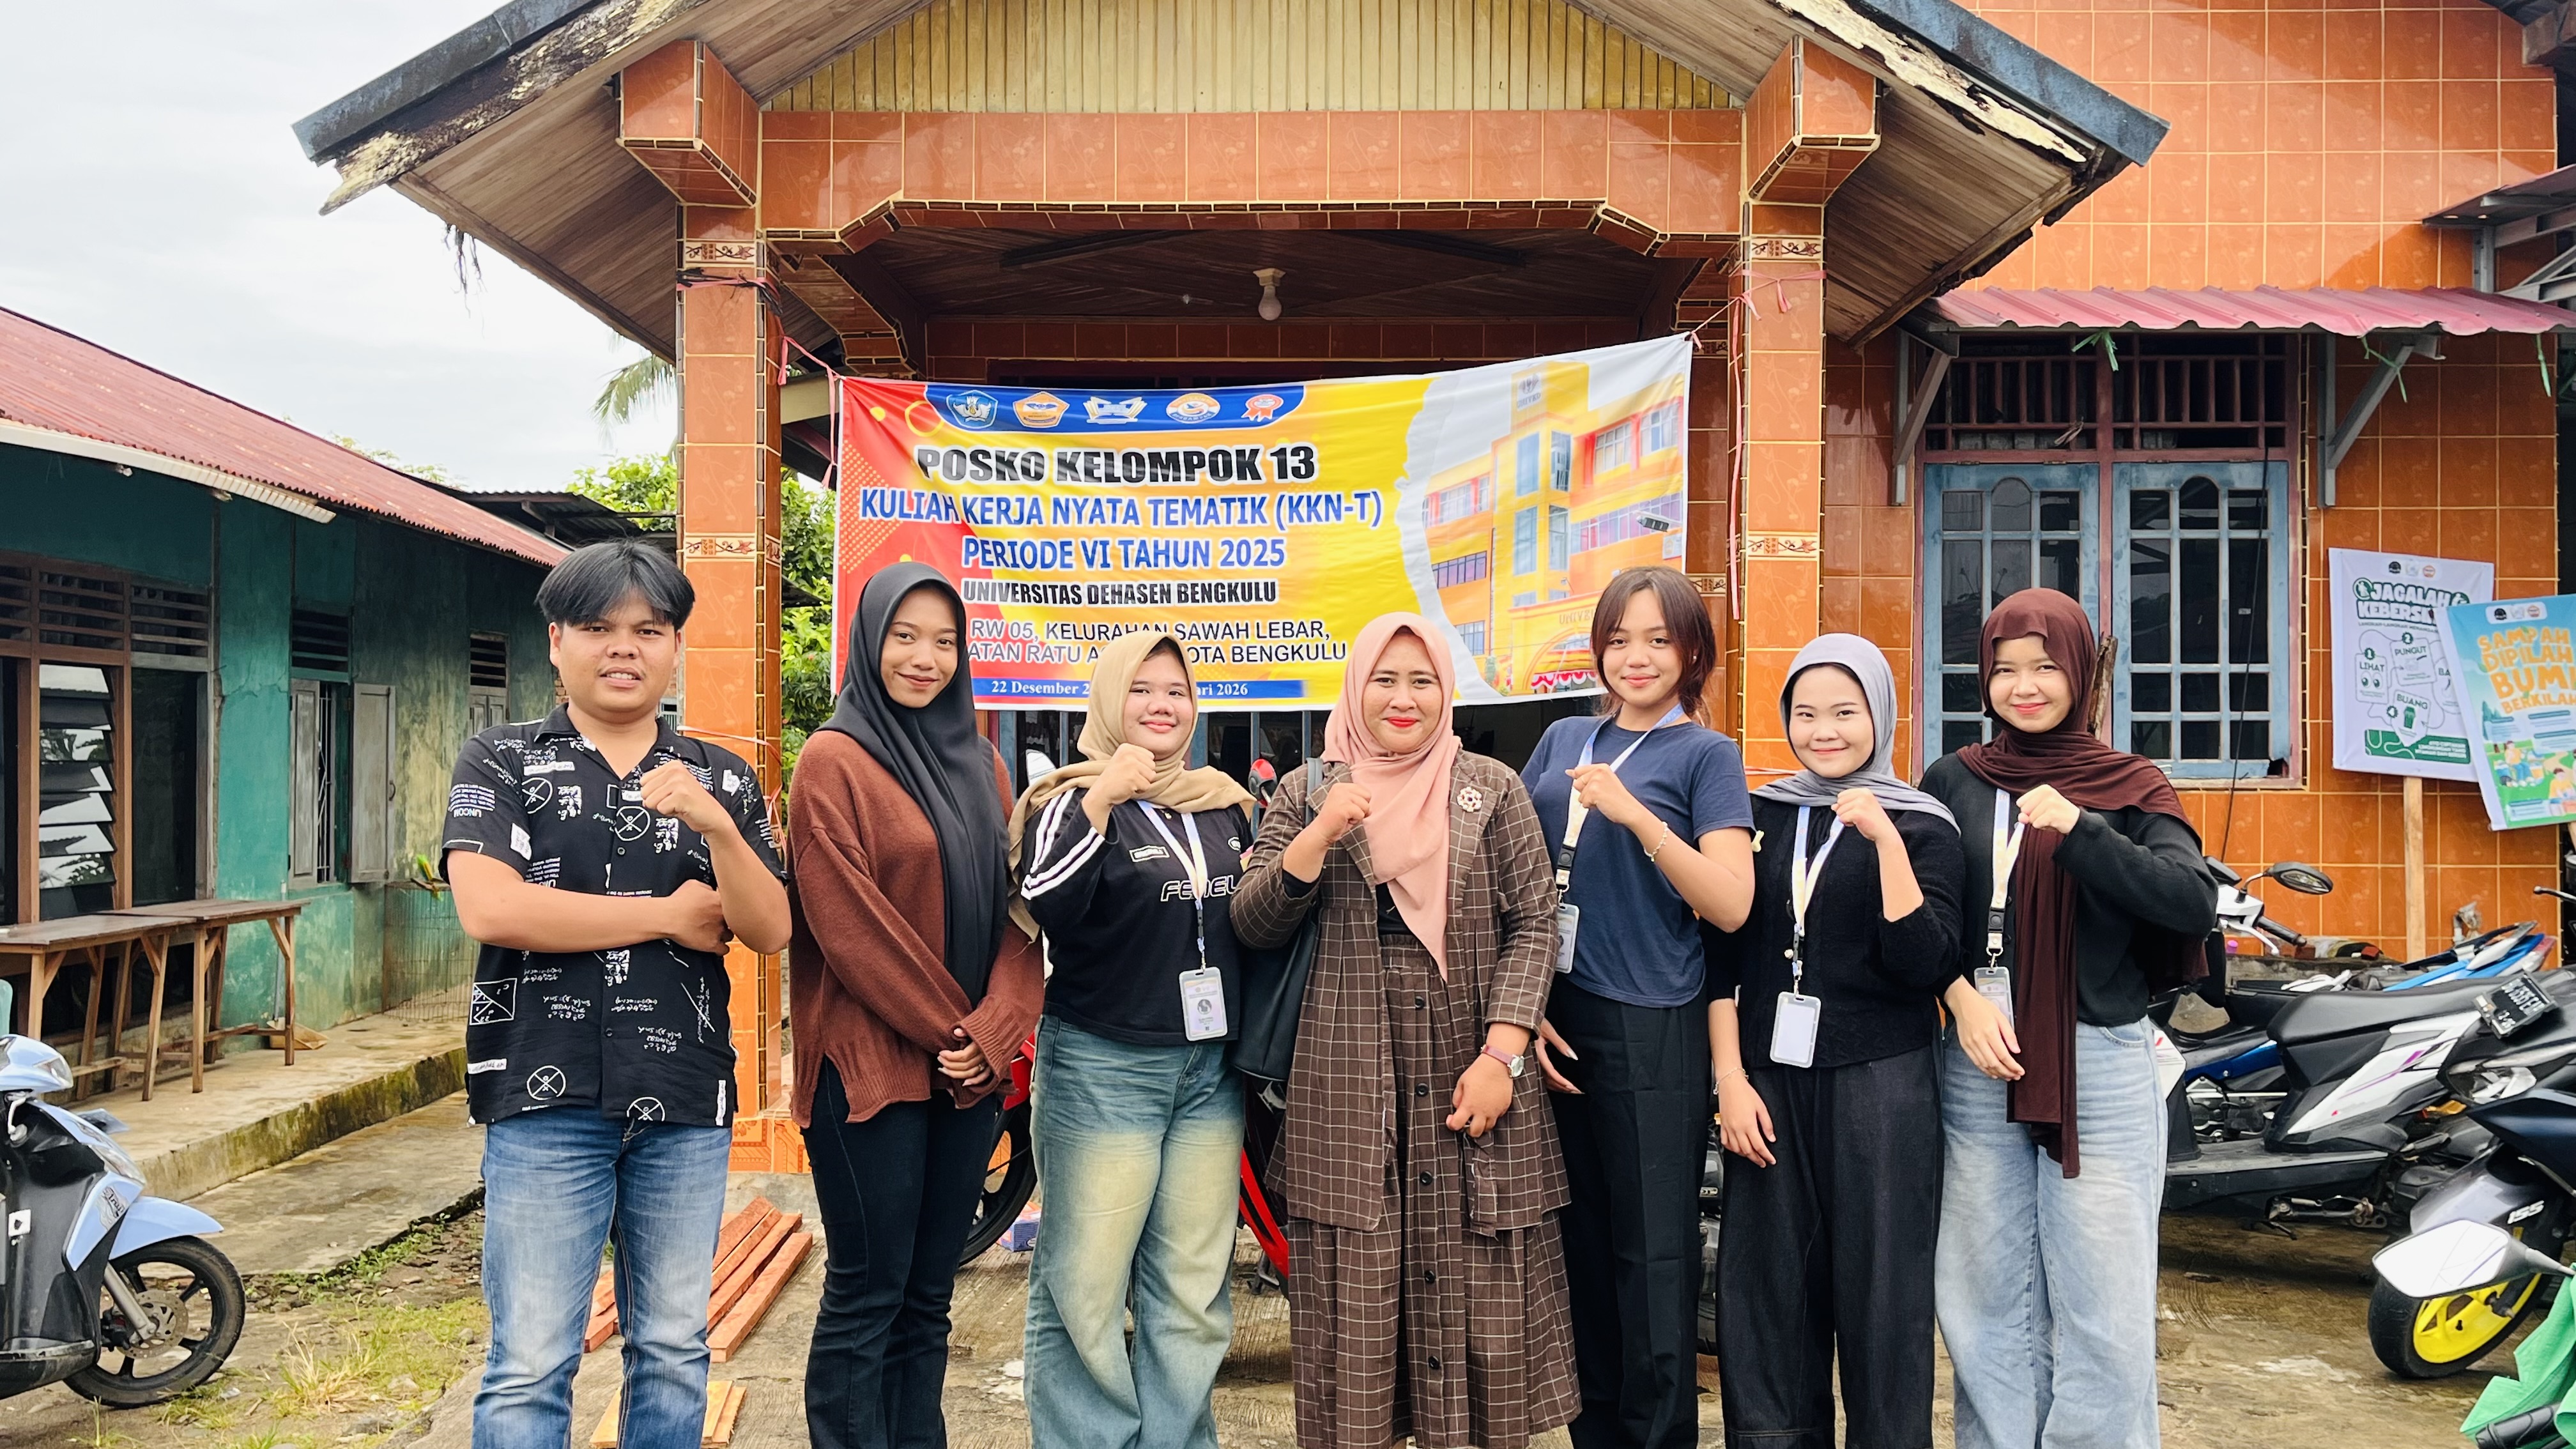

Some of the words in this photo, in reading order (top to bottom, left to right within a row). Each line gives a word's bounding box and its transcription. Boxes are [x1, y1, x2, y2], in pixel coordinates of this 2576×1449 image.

[917, 448, 1045, 482] POSKO
[1057, 448, 1262, 483] KELOMPOK
[1270, 446, 1315, 480] 13
[862, 489, 960, 522] KULIAH
[962, 496, 1043, 525] KERJA
[1053, 497, 1140, 525] NYATA
[1148, 496, 1268, 526] TEMATIK
[1276, 491, 1381, 531] (KKN-T)
[964, 538, 1073, 569] PERIODE
[1080, 540, 1111, 569] VI
[1118, 539, 1209, 568] TAHUN
[1220, 539, 1285, 567] 2025
[963, 581, 1082, 605] UNIVERSITAS
[1087, 583, 1171, 604] DEHASEN
[1177, 581, 1276, 604] BENGKULU
[2370, 583, 2450, 608] JAGALAH
[972, 620, 1004, 638] RW
[1010, 622, 1039, 644] 05,
[1175, 622, 1249, 640] SAWAH
[1256, 620, 1330, 640] LEBAR,
[2478, 627, 2570, 653] SAMPAH
[1027, 645, 1080, 663] RATU
[1187, 646, 1225, 664] OTA
[1232, 643, 1346, 663] BENGKULU
[2481, 645, 2573, 672] DIPILAH
[2359, 661, 2385, 673] LIHAT
[992, 680, 1007, 693] 22
[1011, 680, 1079, 694] Desember
[1216, 683, 1248, 696] 2026
[2506, 1200, 2545, 1225] 155
